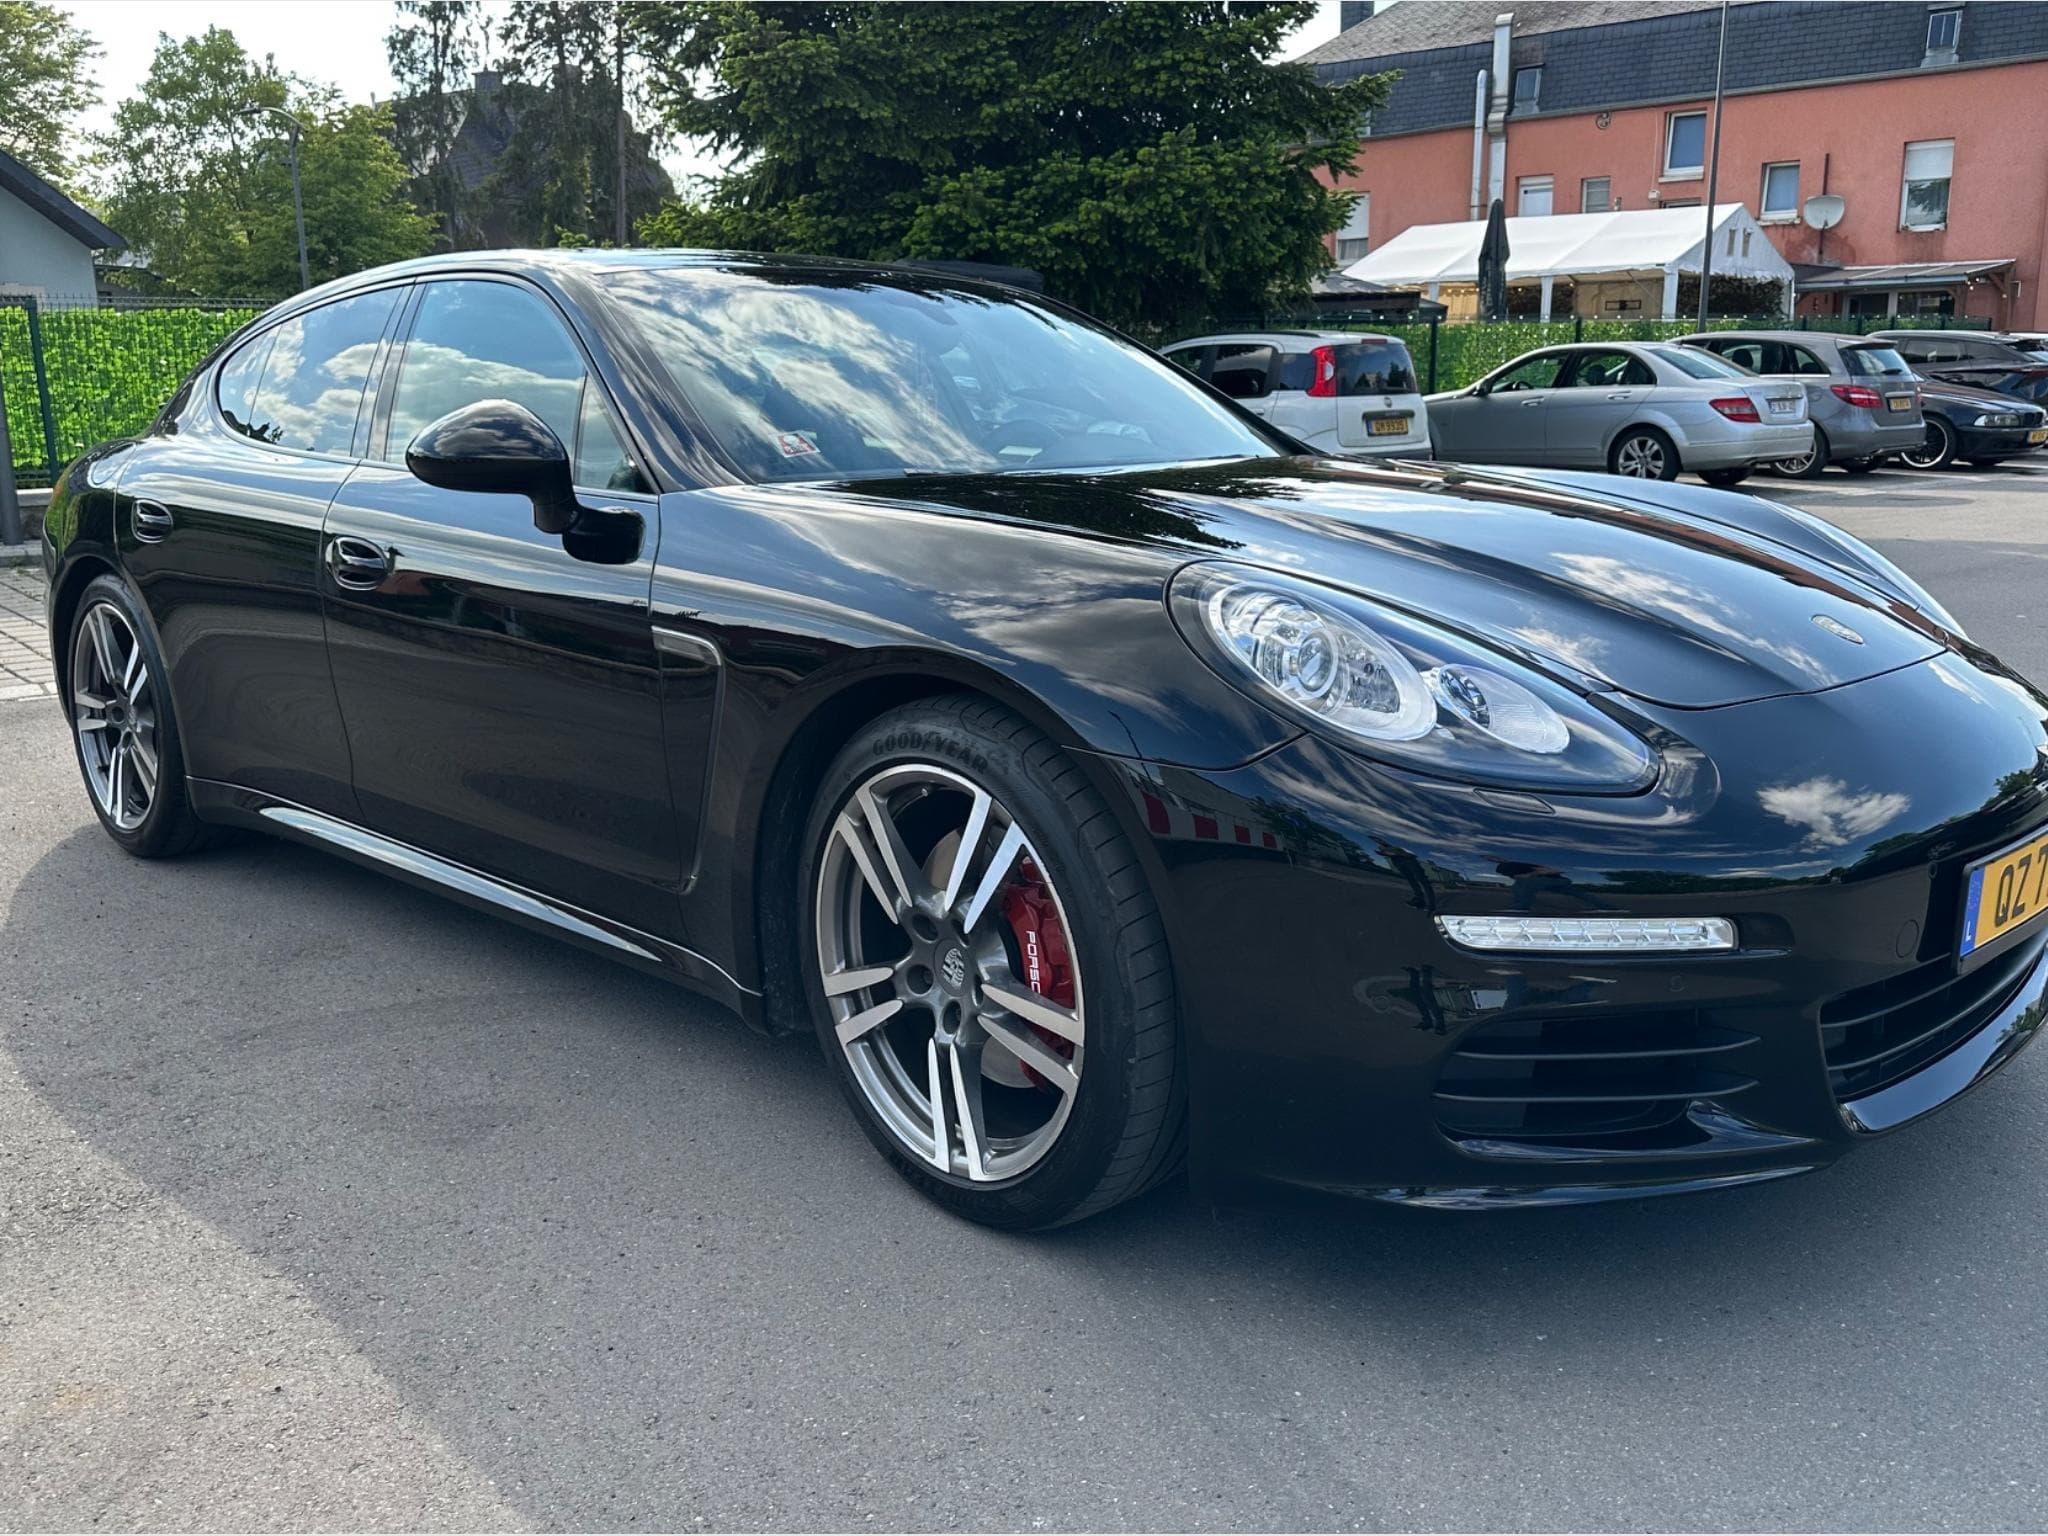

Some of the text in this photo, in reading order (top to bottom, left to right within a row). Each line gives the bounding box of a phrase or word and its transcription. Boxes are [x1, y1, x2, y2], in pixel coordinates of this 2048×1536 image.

[872, 731, 989, 774] GOODYEAR
[1994, 844, 2048, 928] QZ 7
[1965, 920, 1972, 942] L
[1025, 930, 1041, 994] PORSC
